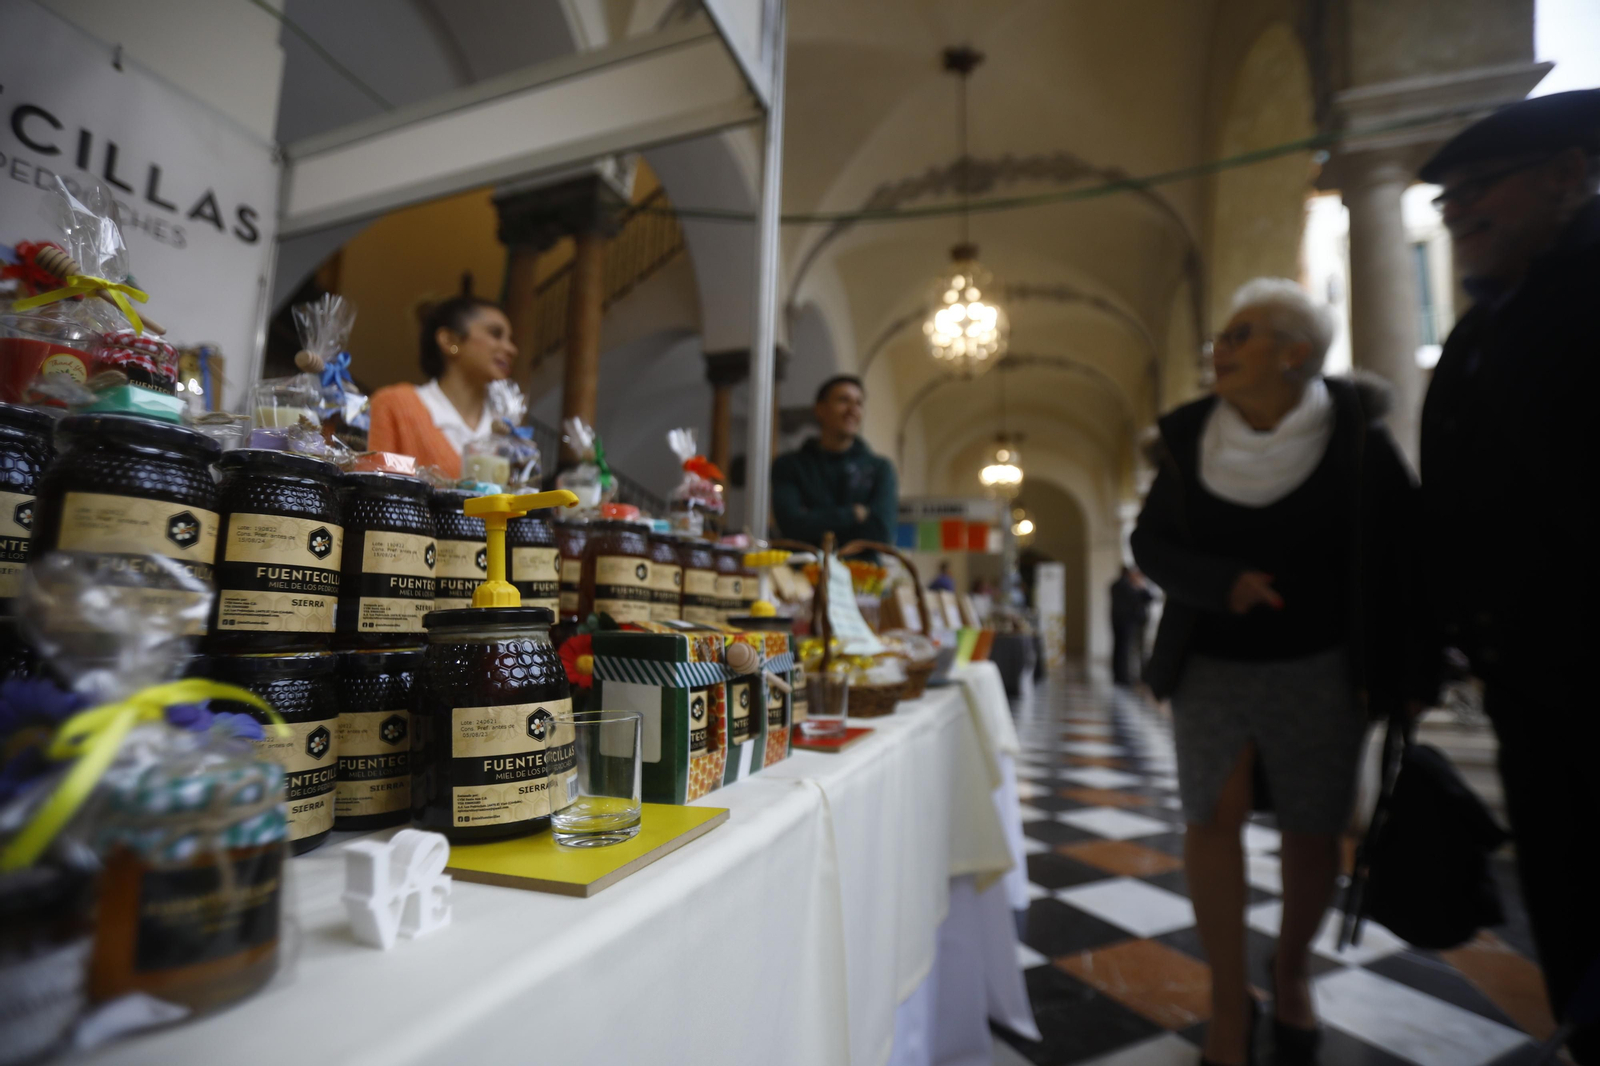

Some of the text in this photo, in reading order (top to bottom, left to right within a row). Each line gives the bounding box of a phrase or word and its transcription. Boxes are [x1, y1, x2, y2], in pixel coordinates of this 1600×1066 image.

[0, 84, 260, 243] CILLAS
[268, 581, 289, 589] MIEL
[291, 582, 302, 590] DE
[303, 583, 317, 591] LOS
[291, 598, 325, 608] SIERRA
[495, 772, 515, 780] MIEL
[516, 770, 526, 778] DE
[527, 768, 541, 777] LOS
[291, 788, 302, 797] DE
[303, 784, 317, 796] LOS
[369, 781, 404, 793] SIERRA
[291, 800, 325, 815] SIERRA
